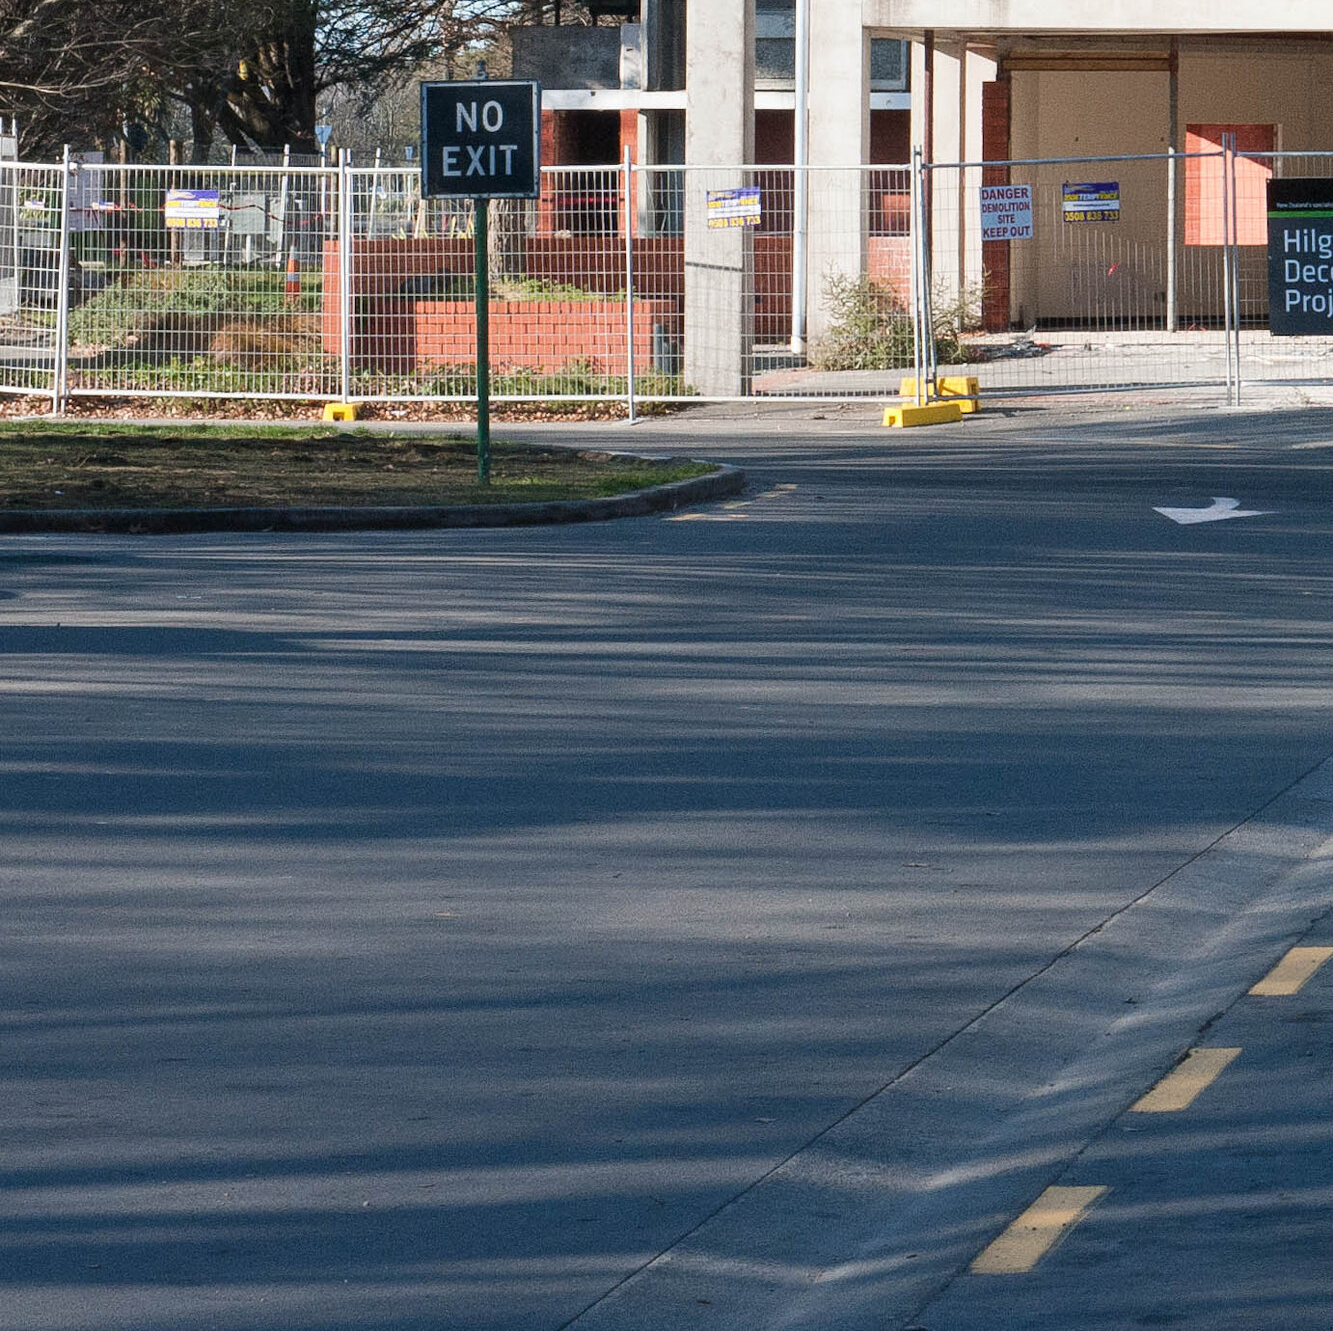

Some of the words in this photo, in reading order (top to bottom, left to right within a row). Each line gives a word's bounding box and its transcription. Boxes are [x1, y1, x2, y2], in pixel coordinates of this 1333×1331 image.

[456, 100, 503, 133] NO
[442, 144, 518, 177] EXIT
[982, 188, 1029, 200] DANGER
[982, 202, 1030, 213] DEMOLITION
[998, 214, 1015, 224] SITE
[983, 227, 1008, 238] KEEP
[1010, 226, 1030, 237] OUT
